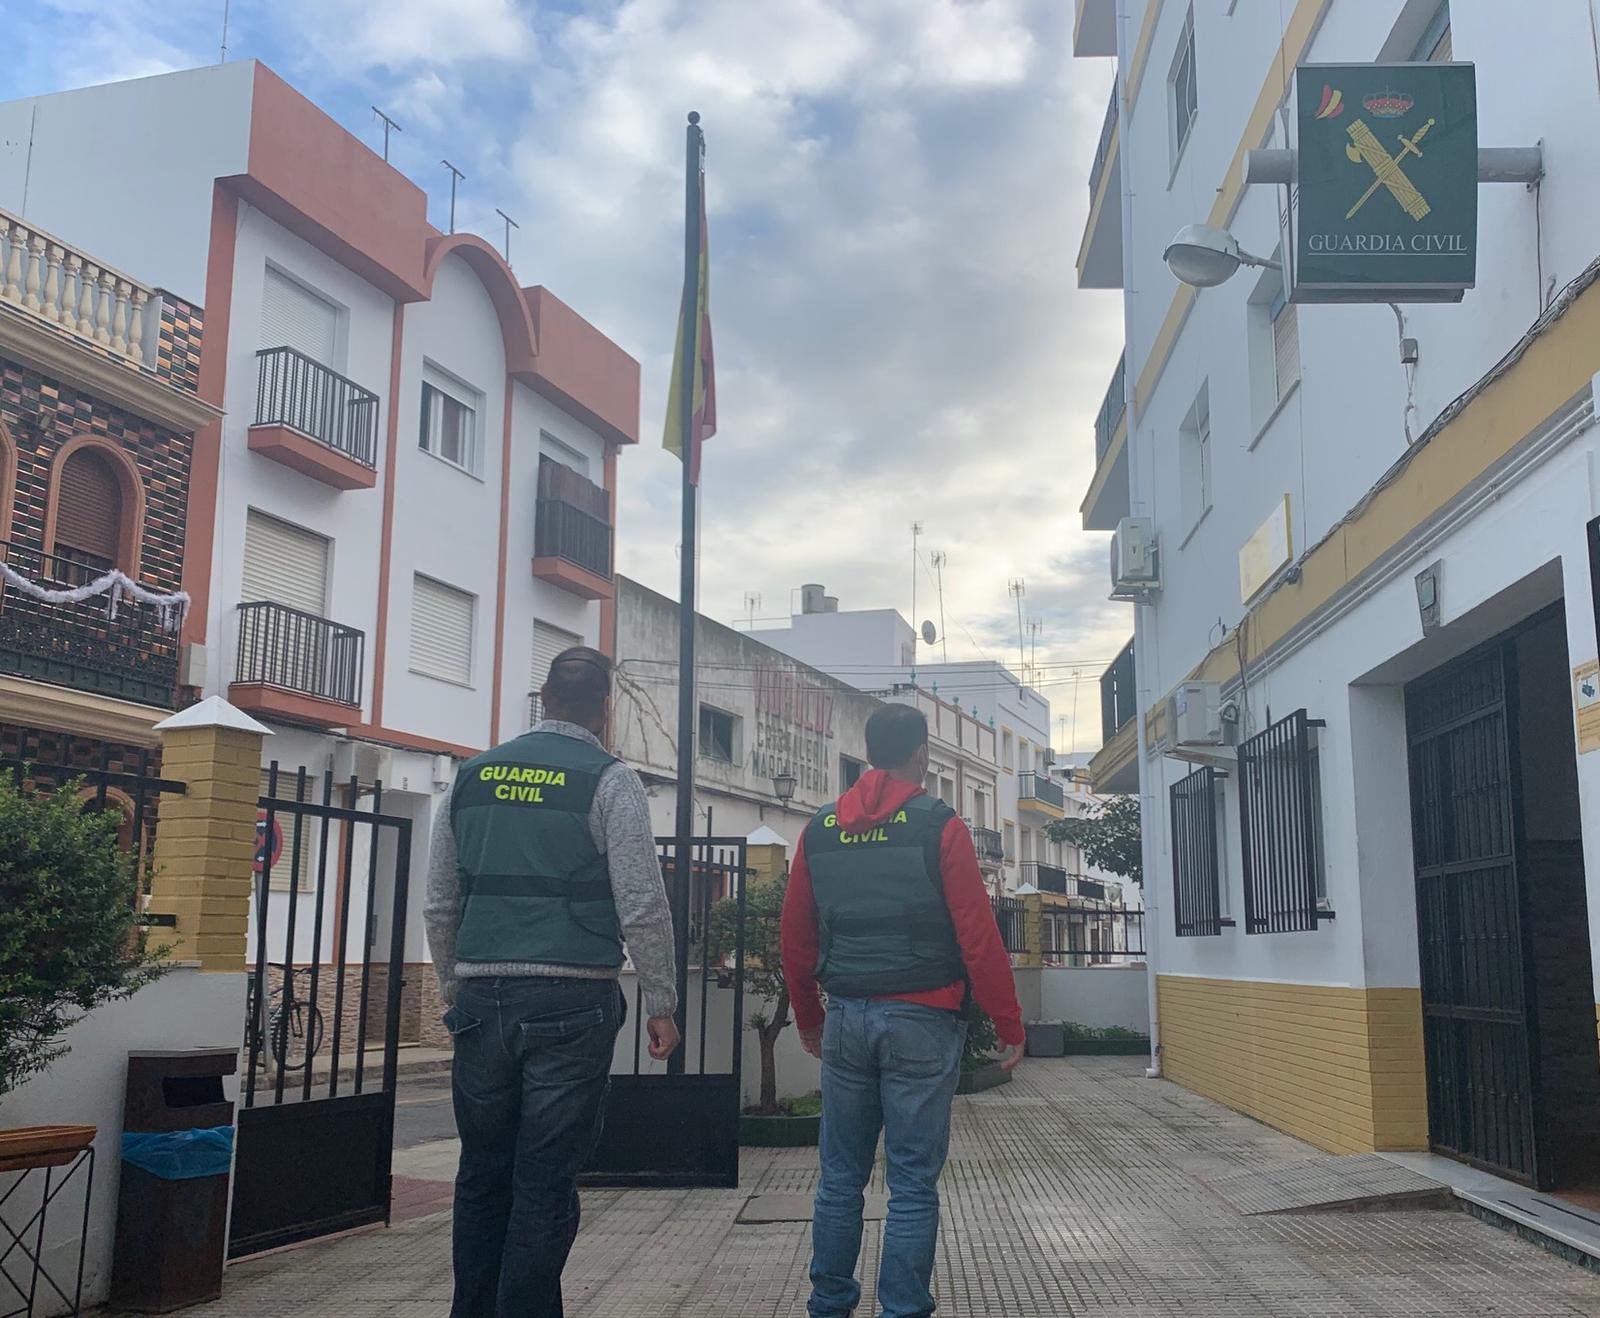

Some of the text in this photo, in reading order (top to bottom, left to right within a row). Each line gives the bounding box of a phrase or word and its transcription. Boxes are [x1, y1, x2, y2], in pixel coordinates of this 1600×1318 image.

[1308, 234, 1467, 251] GUARDIA CIVIL
[480, 766, 565, 786] GUARDIA
[495, 784, 544, 802] CIVIL
[840, 828, 888, 844] CIVIL
